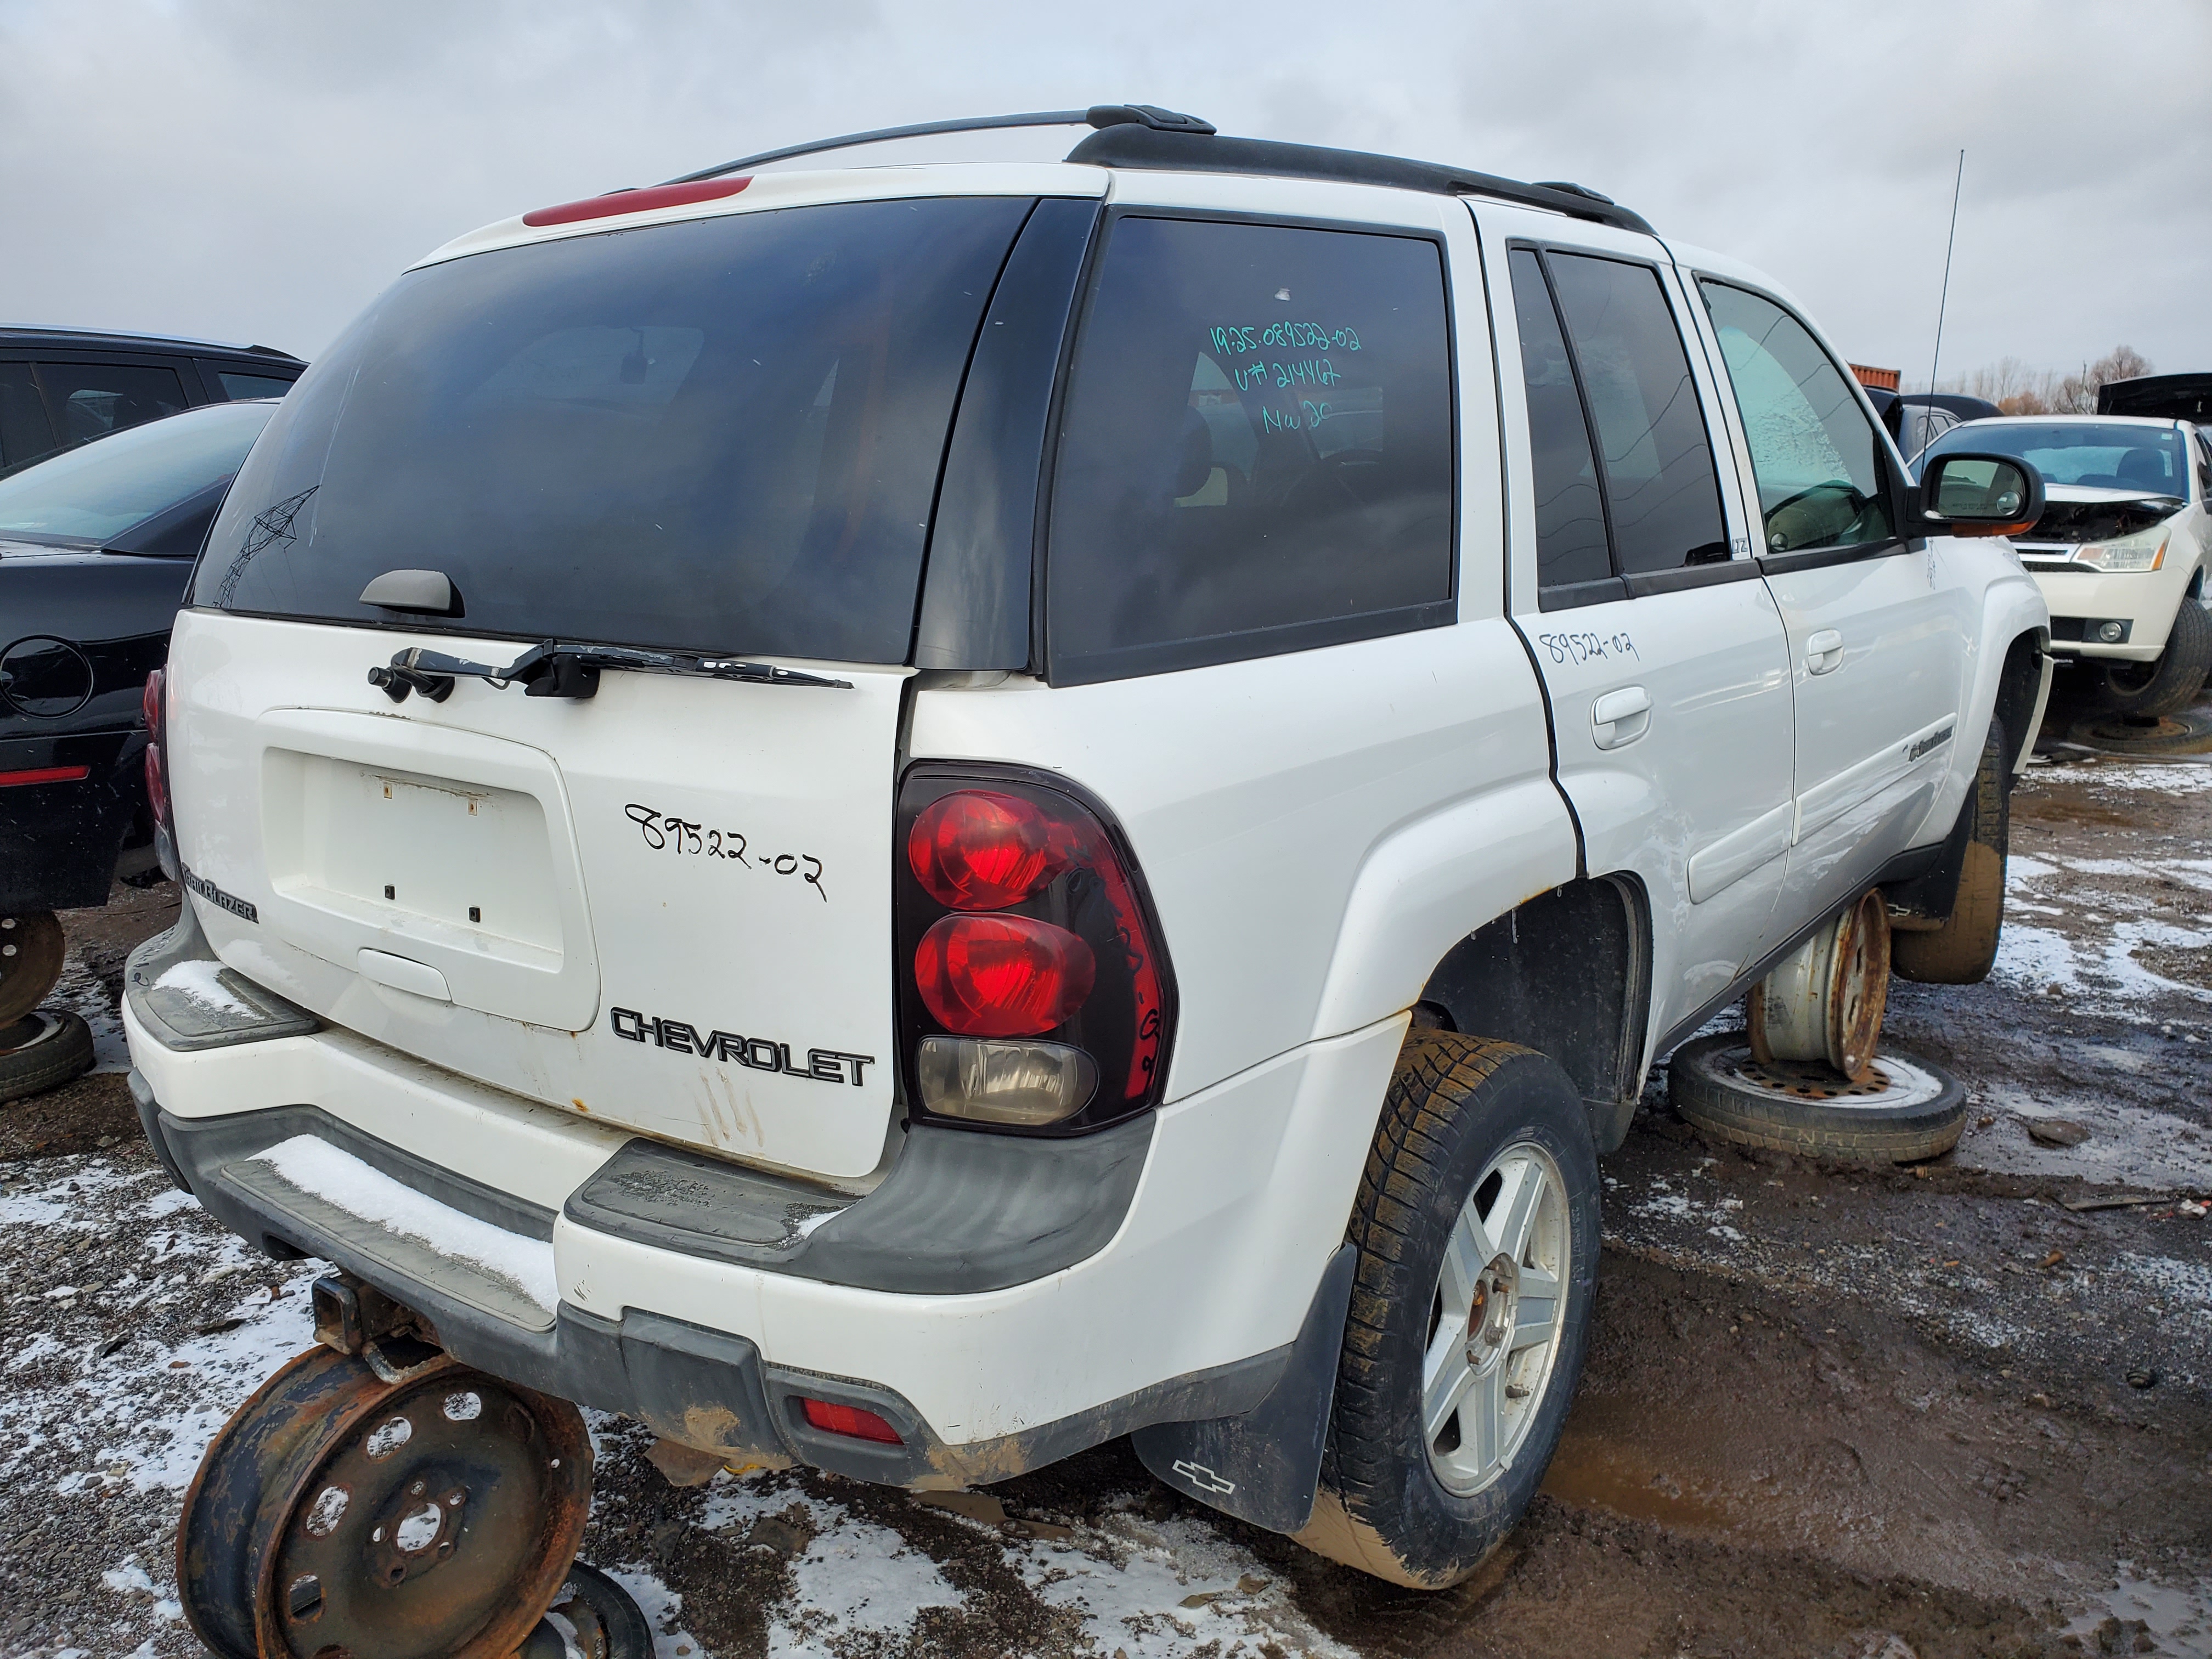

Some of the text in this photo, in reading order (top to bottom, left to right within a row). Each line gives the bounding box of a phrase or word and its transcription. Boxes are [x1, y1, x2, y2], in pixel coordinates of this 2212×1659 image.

[1538, 632, 1640, 666] 89522-02
[624, 803, 828, 903] 89522-02
[610, 1006, 876, 1087] CHEVROLET
